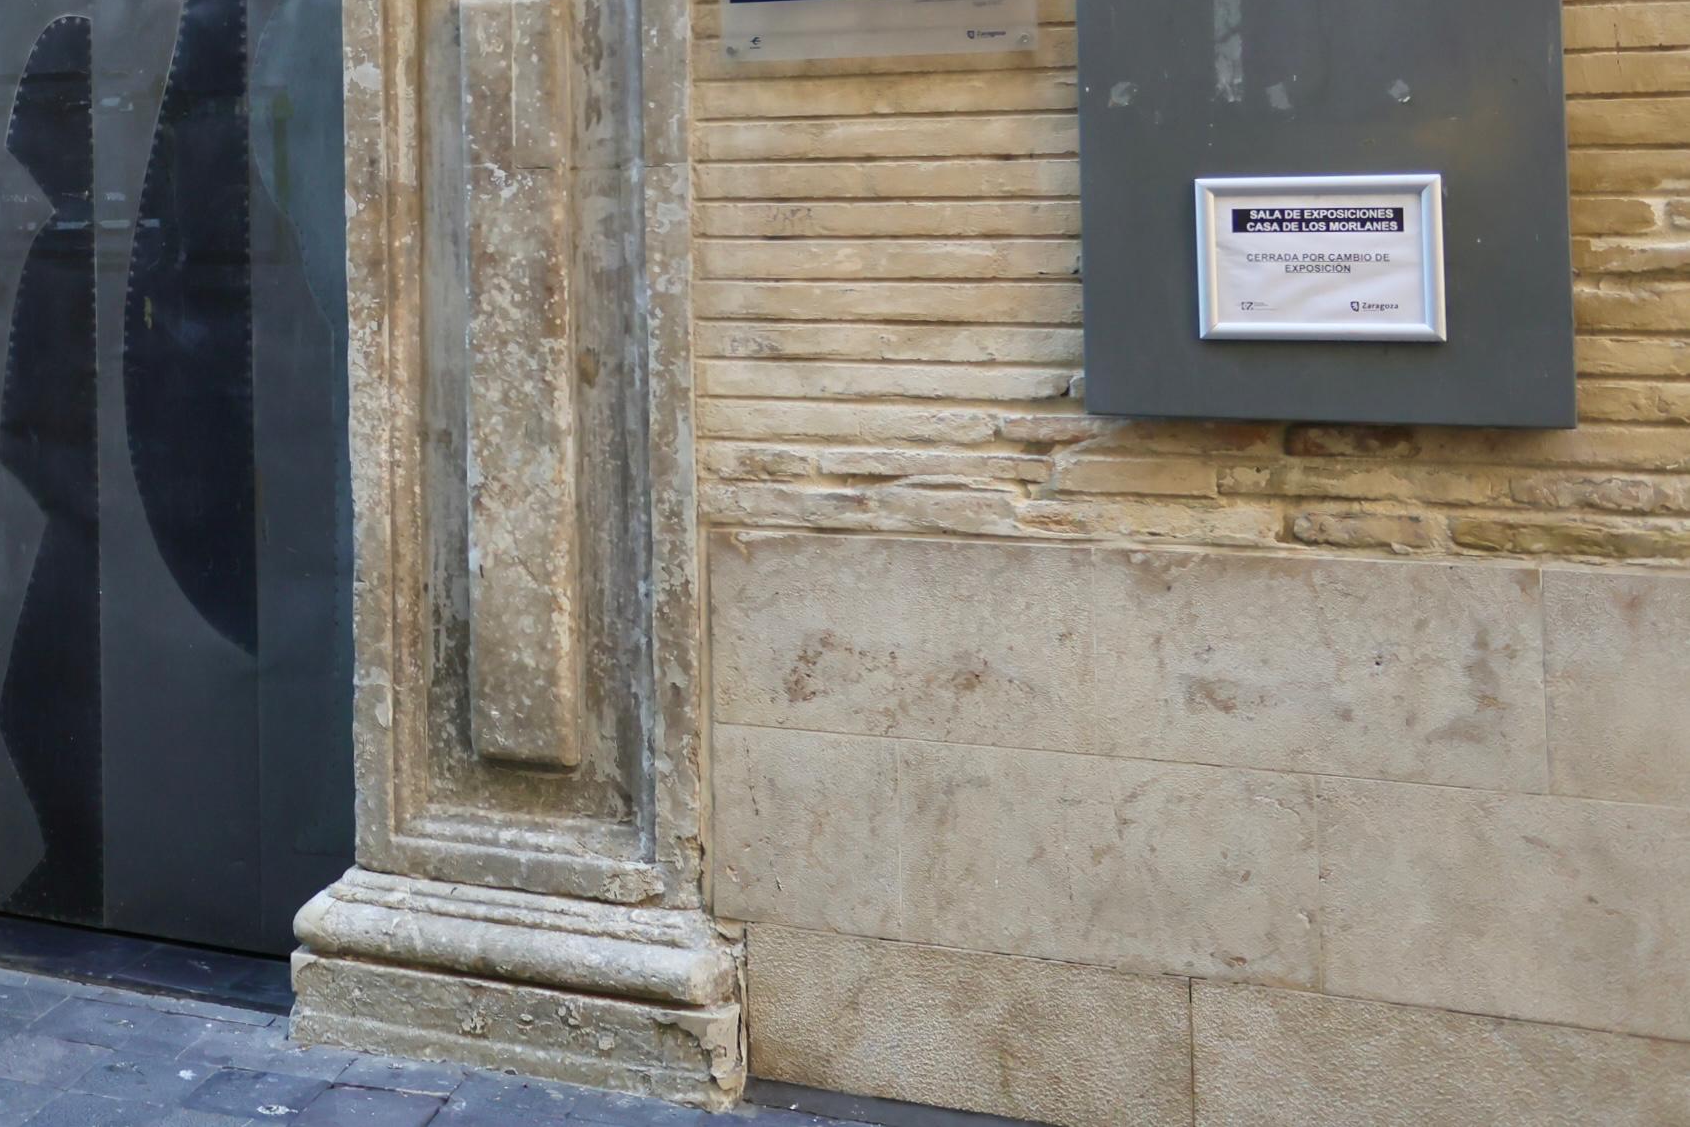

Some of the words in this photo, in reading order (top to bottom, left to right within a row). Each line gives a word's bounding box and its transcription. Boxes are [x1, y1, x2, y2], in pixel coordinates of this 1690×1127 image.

[1249, 209, 1281, 220] SALA
[1284, 209, 1302, 220] DE
[1304, 208, 1394, 220] EXPOSICIONES
[1246, 221, 1280, 232] CASA
[1284, 221, 1300, 232] DE
[1302, 221, 1327, 232] LOS
[1329, 220, 1399, 232] MORLANES
[1246, 253, 1299, 262] CERRADA
[1302, 253, 1325, 262] POR
[1328, 252, 1372, 262] CAMBIO
[1375, 253, 1390, 262] DE
[1362, 301, 1399, 311] Zaragoza
